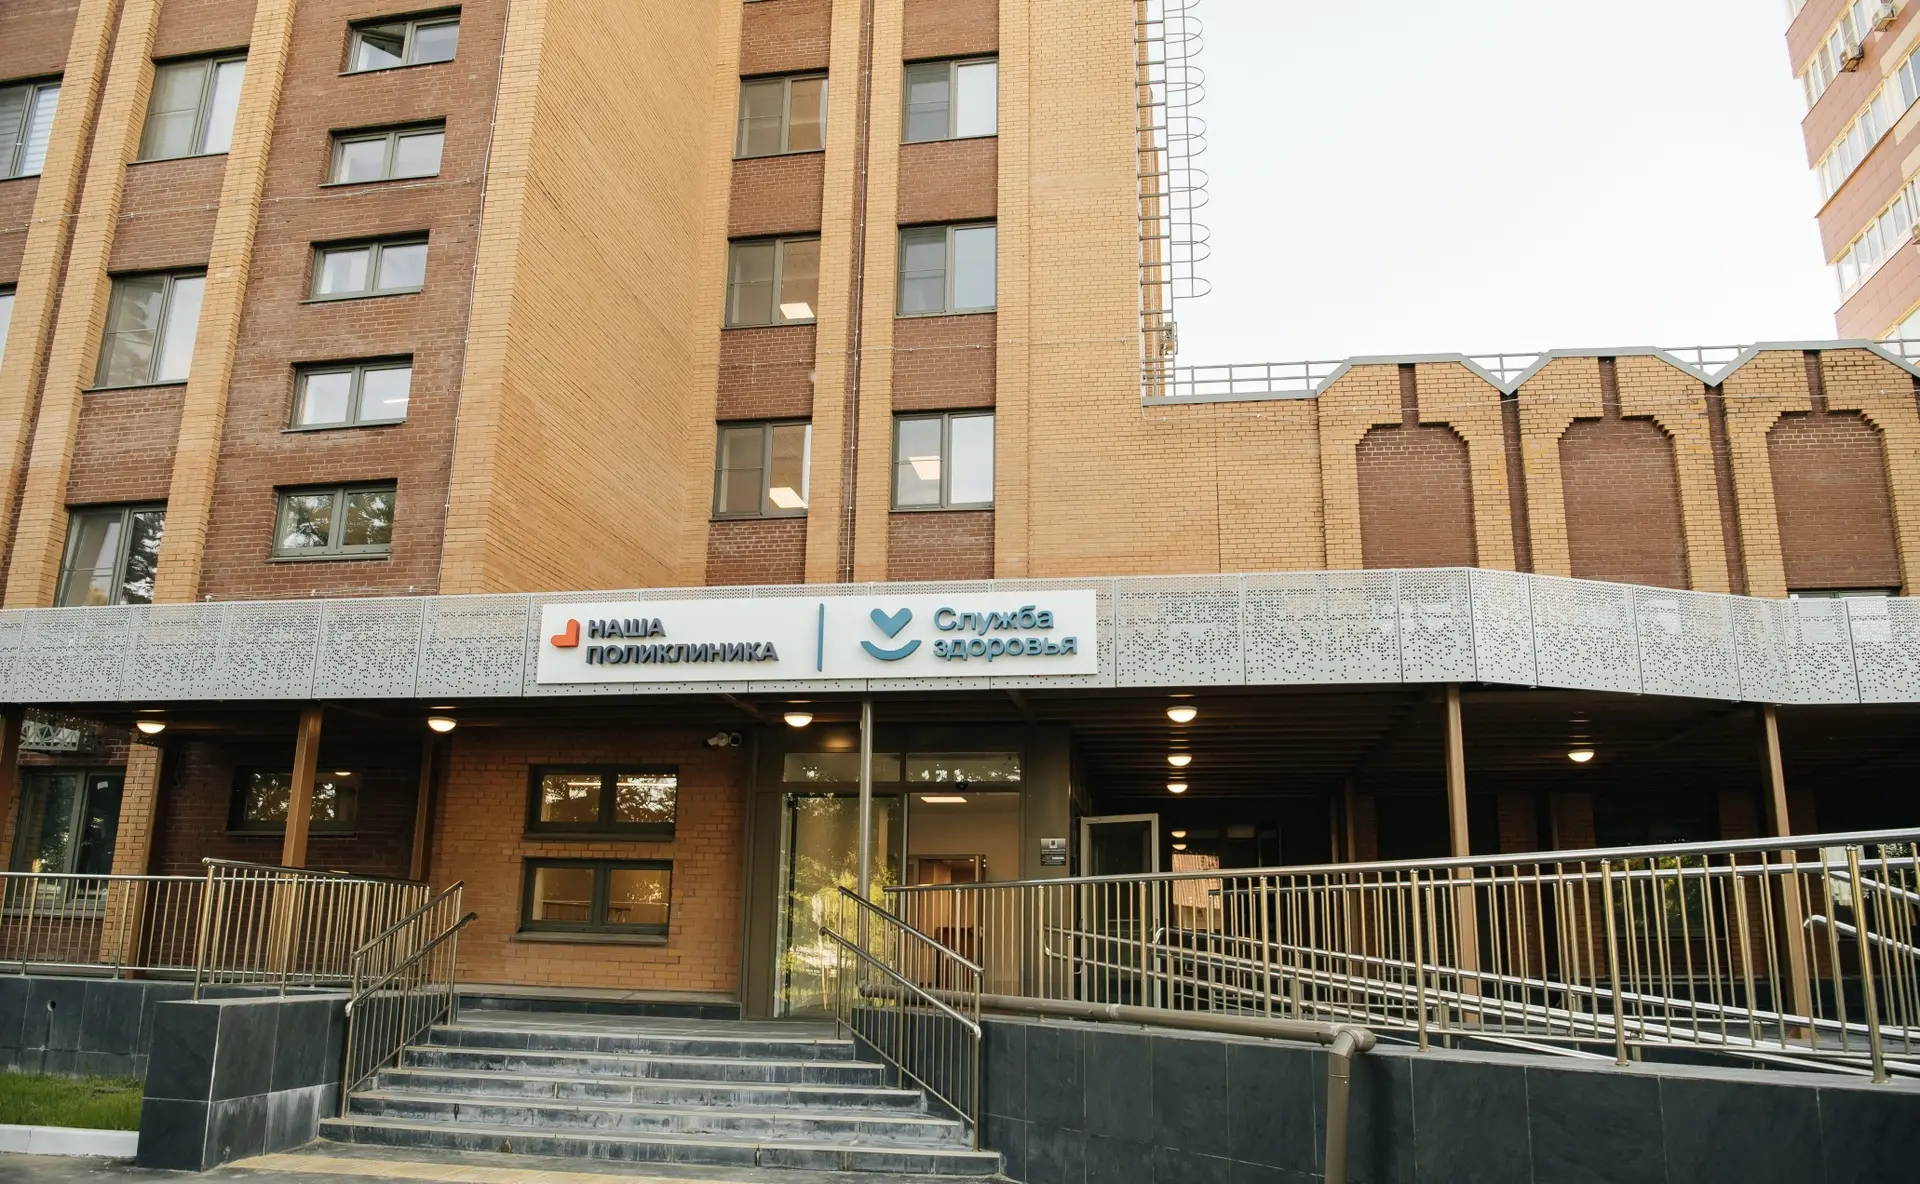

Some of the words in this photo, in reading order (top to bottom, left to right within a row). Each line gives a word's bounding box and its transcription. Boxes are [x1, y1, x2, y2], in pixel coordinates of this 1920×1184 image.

[588, 617, 666, 638] НАША
[934, 605, 1054, 636] Служба
[586, 641, 779, 664] ПОЛИКЛИНИКА
[933, 636, 1078, 661] здоровья
